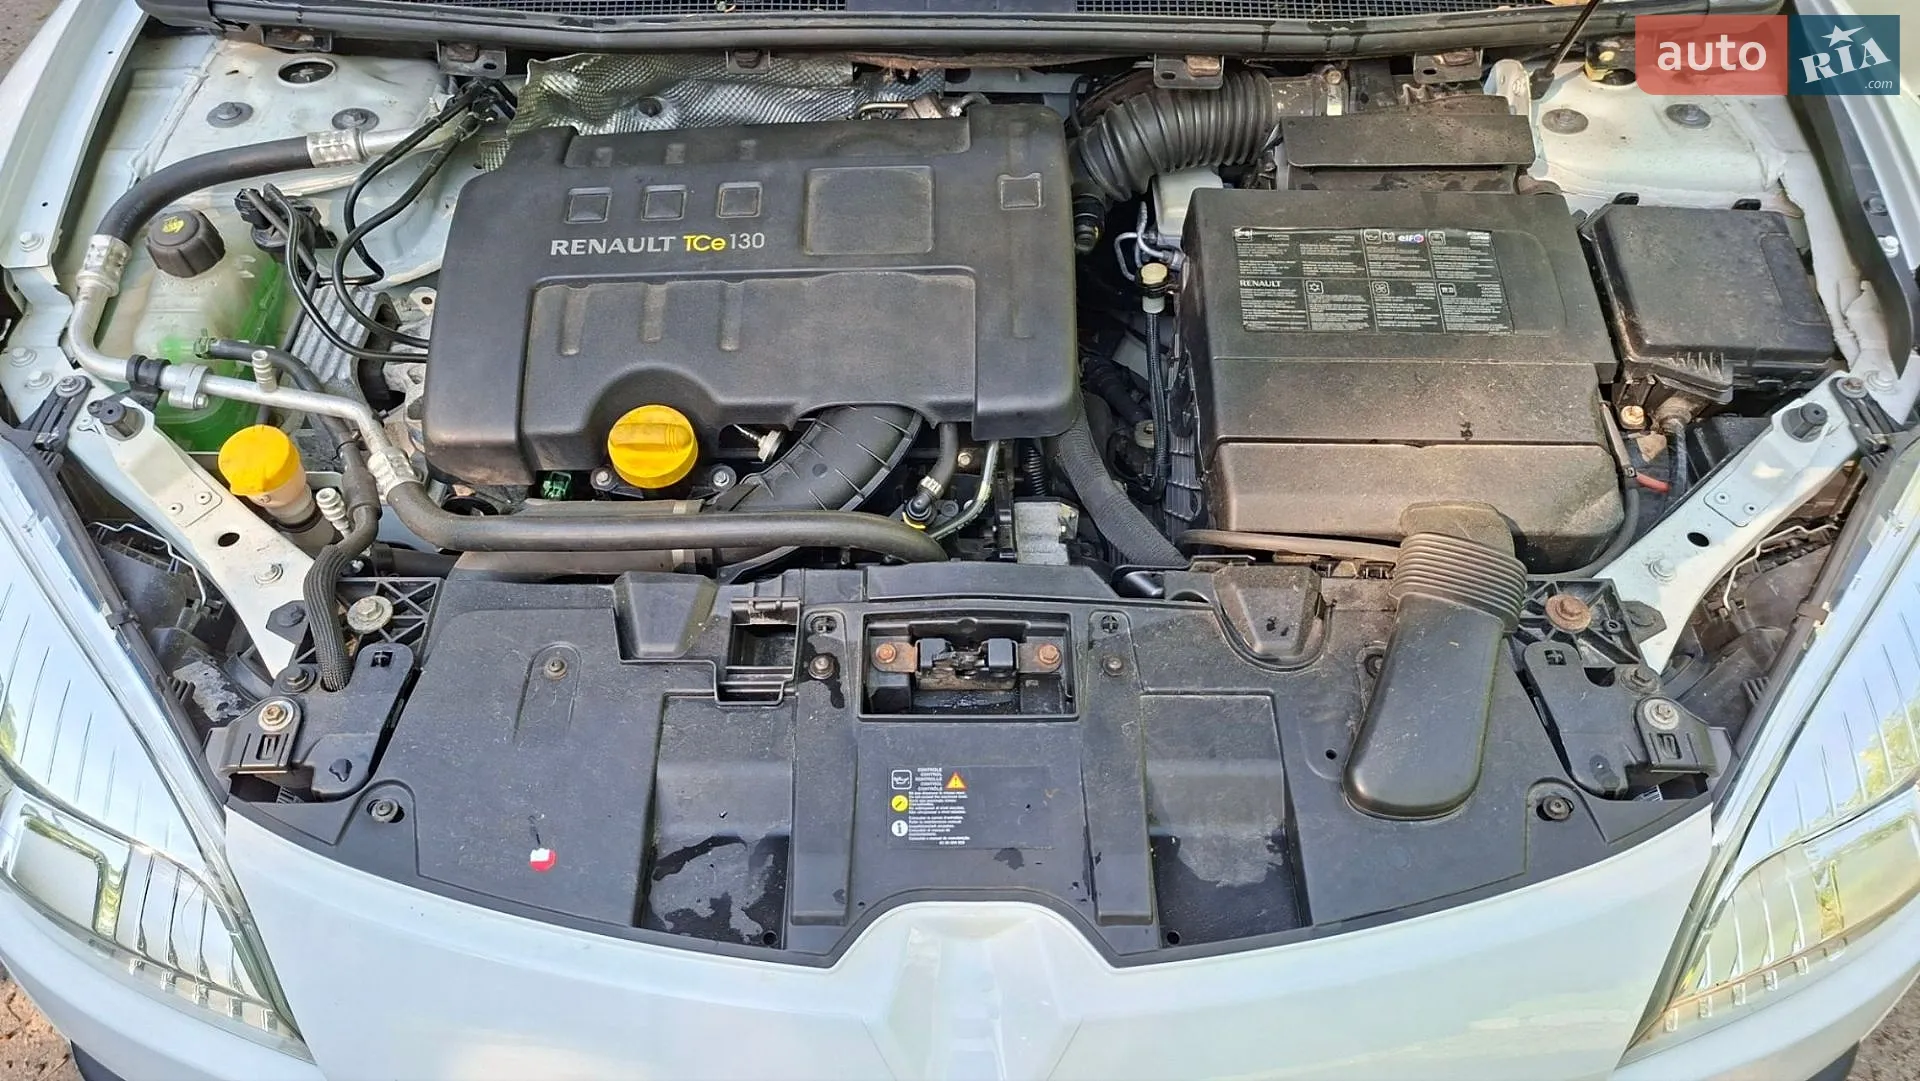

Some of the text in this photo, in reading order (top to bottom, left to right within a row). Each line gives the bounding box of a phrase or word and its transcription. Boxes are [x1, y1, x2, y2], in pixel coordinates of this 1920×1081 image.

[550, 232, 765, 256] RENAULT TCe 130
